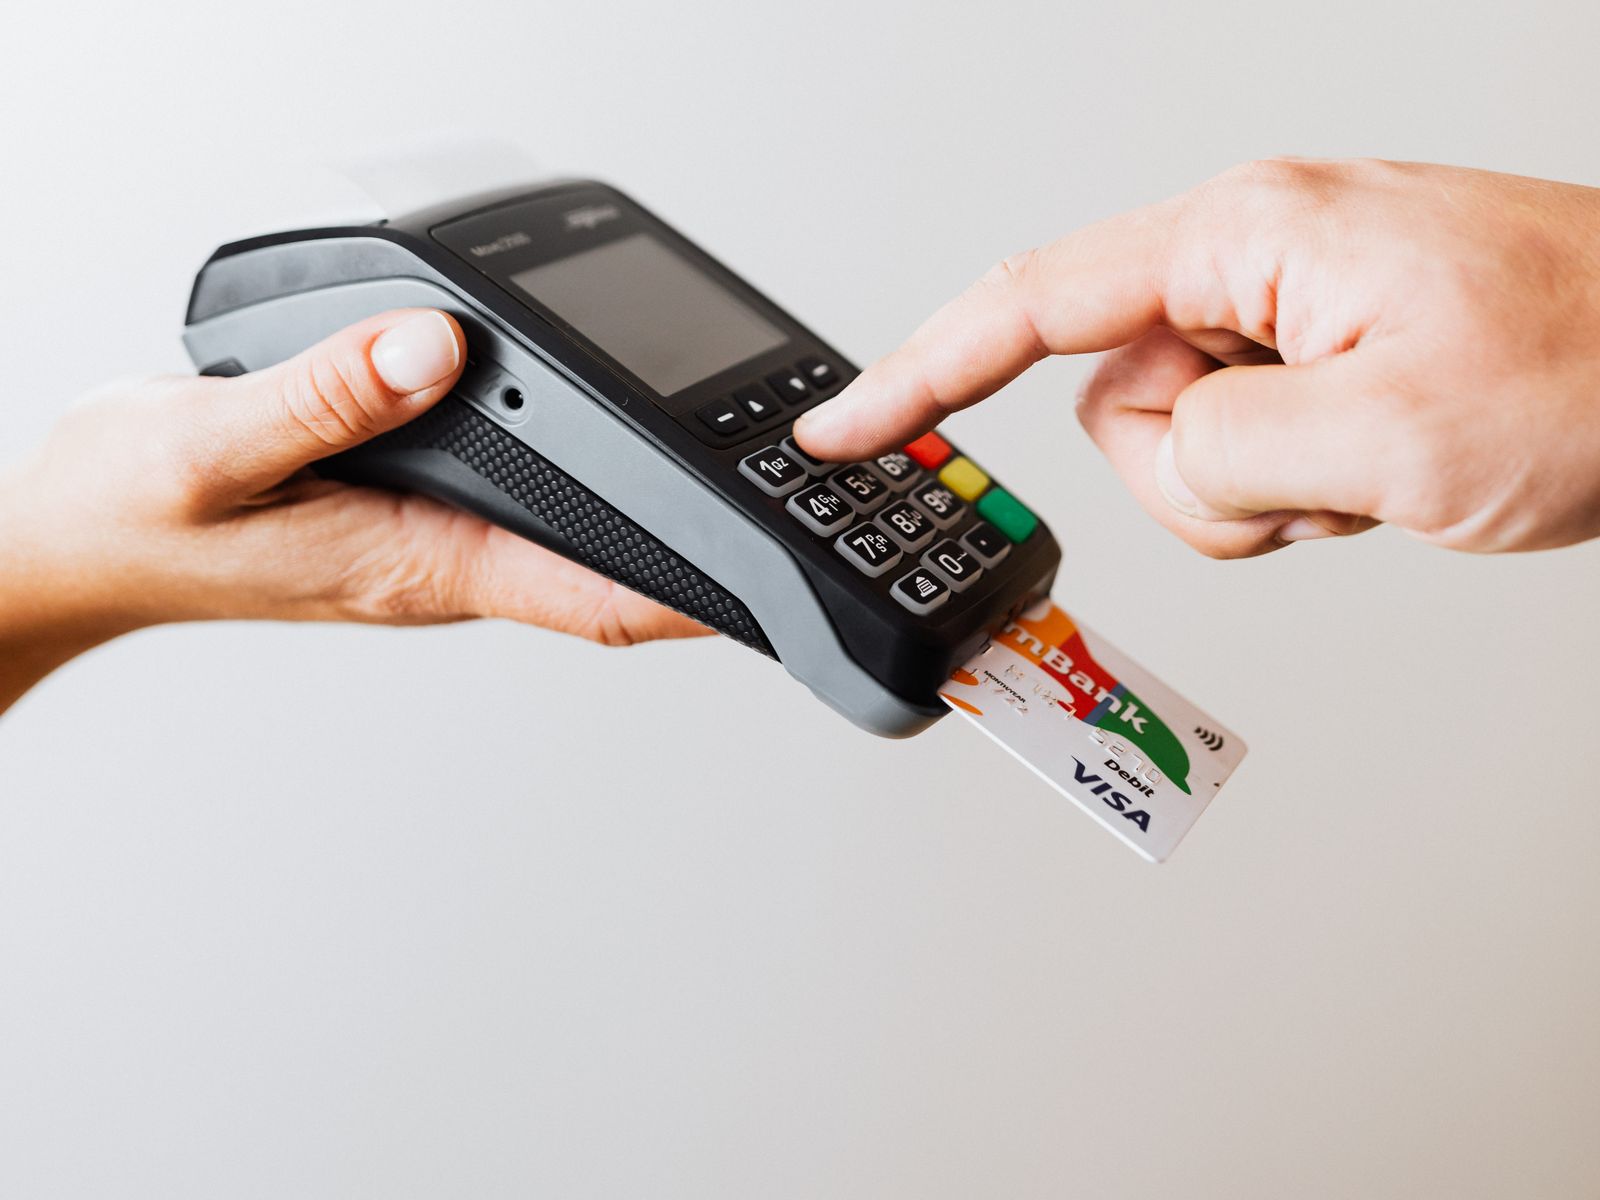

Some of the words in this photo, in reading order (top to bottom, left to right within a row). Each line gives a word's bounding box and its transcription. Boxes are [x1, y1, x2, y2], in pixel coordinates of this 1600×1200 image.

[983, 670, 1026, 704] MONTH/YEAR
[1003, 623, 1149, 734] mBank
[1070, 754, 1151, 833] VISA
[1103, 759, 1155, 798] Debit
